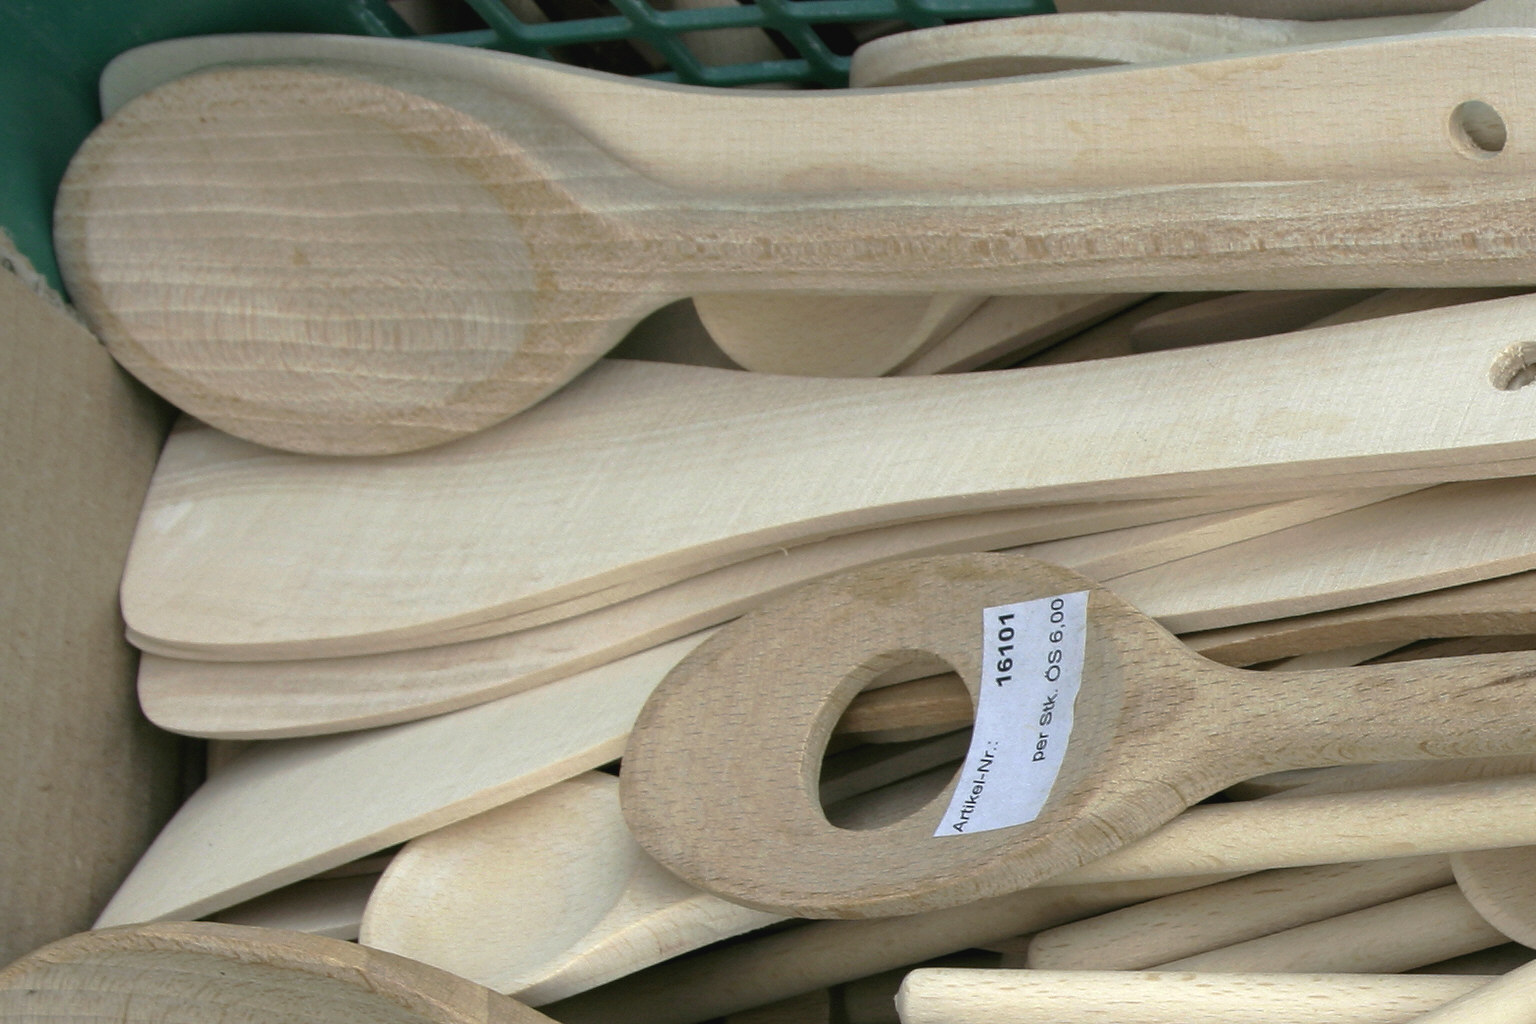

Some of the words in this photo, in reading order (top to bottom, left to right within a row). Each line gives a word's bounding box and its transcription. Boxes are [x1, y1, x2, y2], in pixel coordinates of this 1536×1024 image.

[1049, 598, 1066, 643] 6,00
[1044, 650, 1062, 682] ÖS
[952, 740, 998, 832] Artikel-Nr.:
[996, 613, 1015, 687] 16101
[1039, 689, 1058, 726] Stk.
[1032, 733, 1049, 762] per
